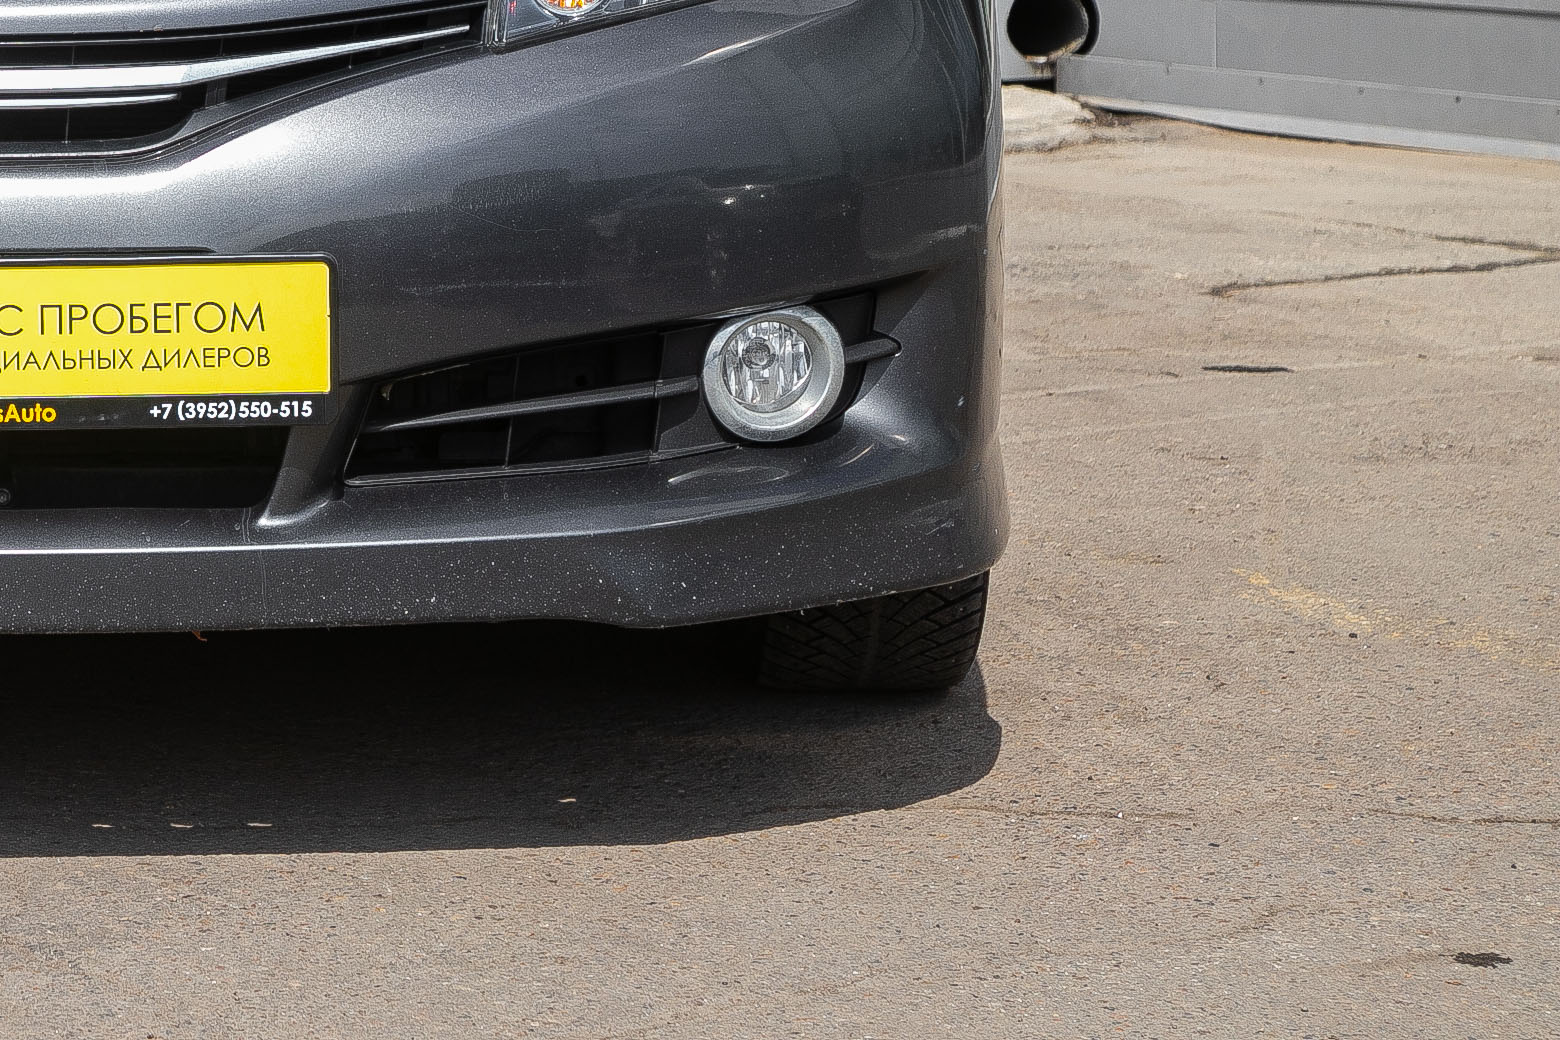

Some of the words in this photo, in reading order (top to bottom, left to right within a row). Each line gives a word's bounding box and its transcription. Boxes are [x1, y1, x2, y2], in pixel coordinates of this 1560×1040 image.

[39, 301, 266, 336] ПРОБЕГОМ
[141, 345, 271, 372] ДИЛЕРОВ
[149, 403, 173, 420] +7
